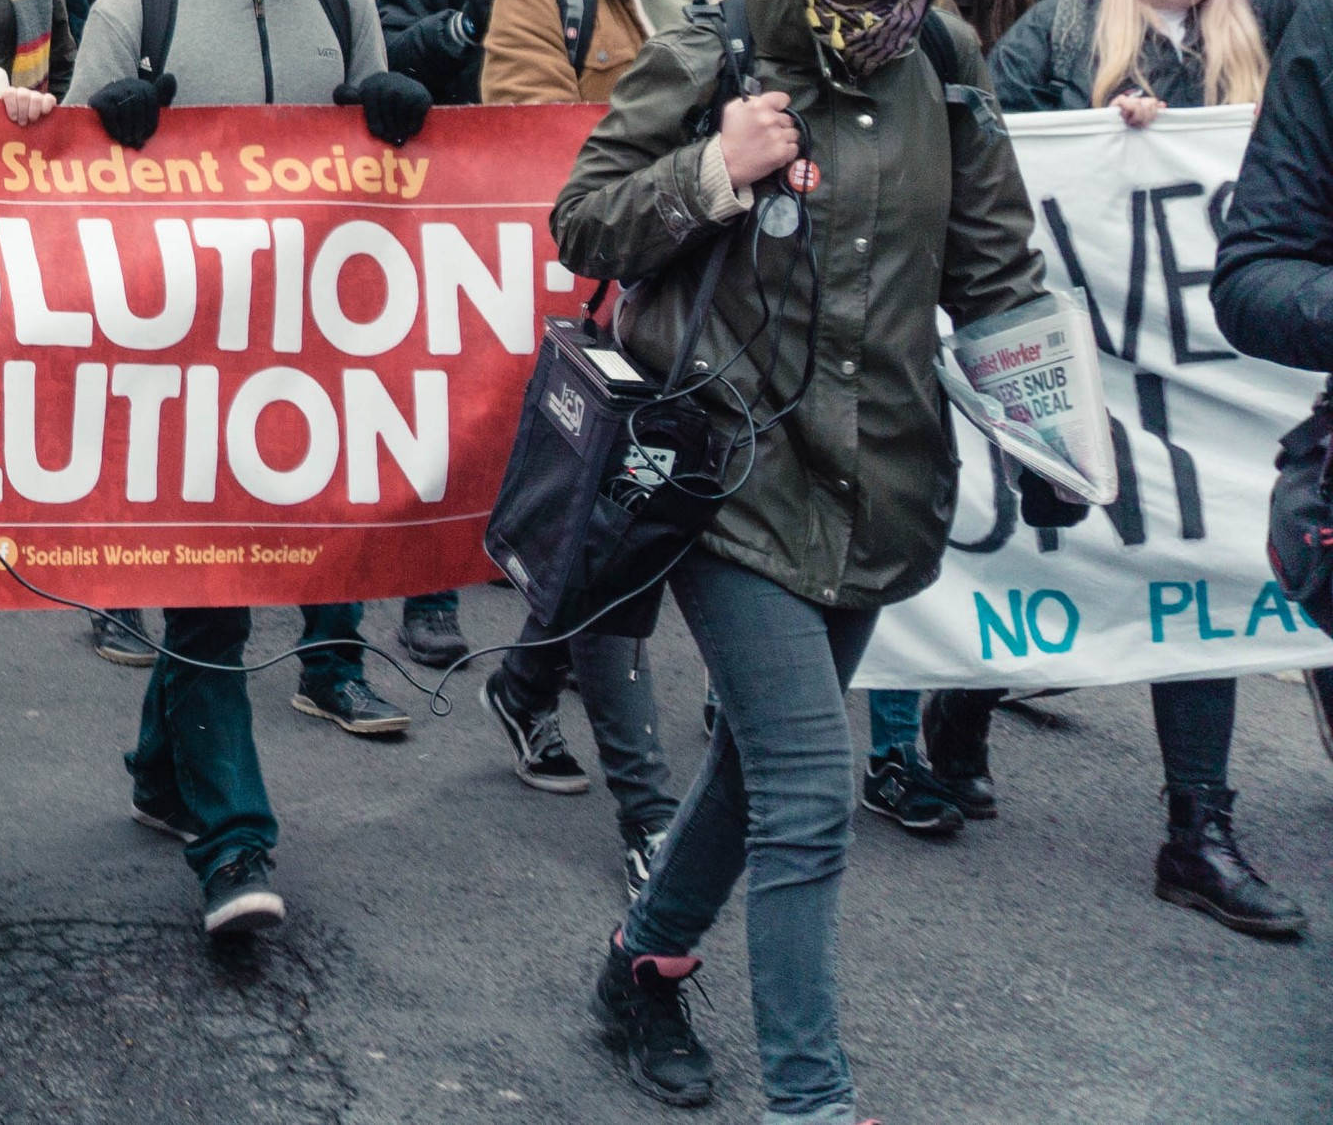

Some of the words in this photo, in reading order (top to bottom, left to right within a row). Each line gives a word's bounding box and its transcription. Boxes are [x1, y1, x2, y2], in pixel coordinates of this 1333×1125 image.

[2, 141, 223, 196] Student
[240, 144, 430, 200] Society
[1023, 366, 1068, 397] SNUB
[1031, 390, 1074, 422] DEAL
[103, 546, 170, 565] Worker
[175, 545, 245, 565] Student
[973, 588, 1081, 660] NO
